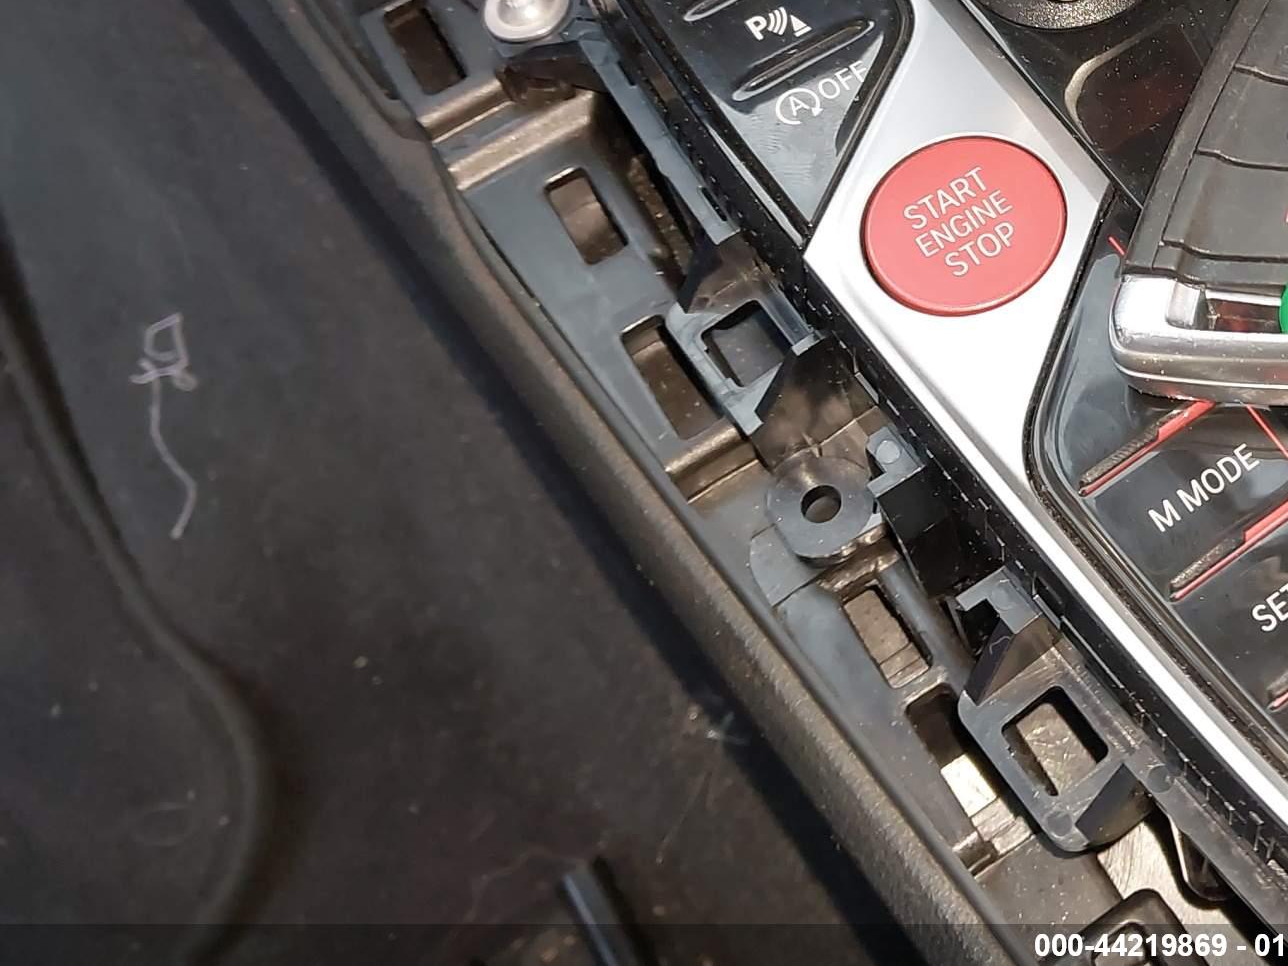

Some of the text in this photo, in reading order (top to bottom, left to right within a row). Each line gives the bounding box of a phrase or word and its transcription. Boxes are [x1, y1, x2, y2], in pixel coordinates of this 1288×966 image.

[818, 60, 867, 99] OFF
[903, 166, 988, 231] START
[915, 190, 1013, 259] ENGINE
[944, 221, 1016, 279] STOP
[1148, 443, 1261, 532] M MODE
